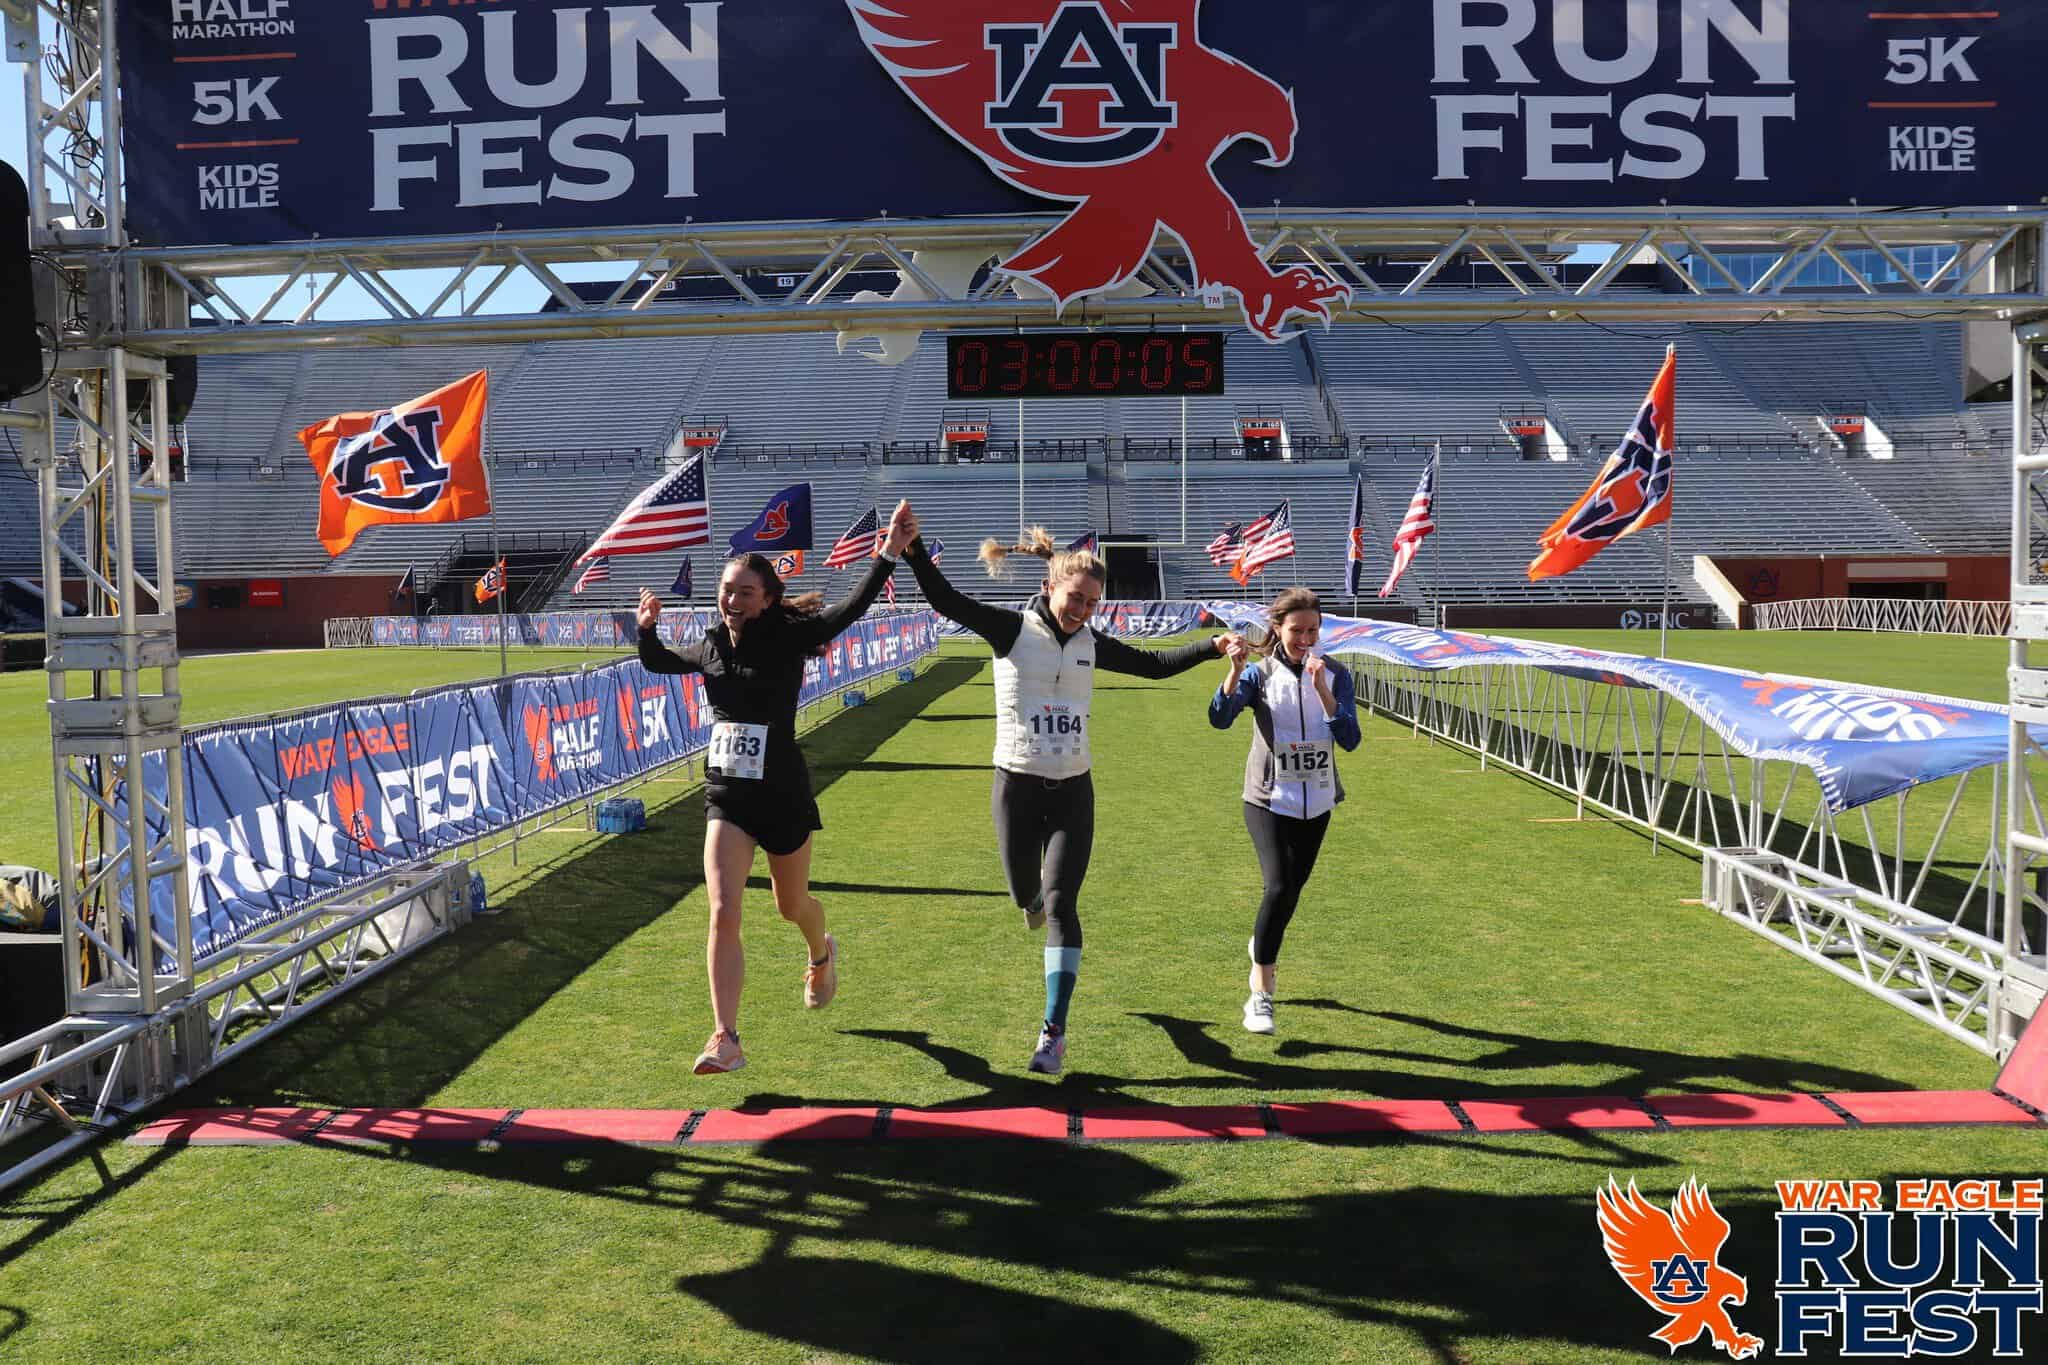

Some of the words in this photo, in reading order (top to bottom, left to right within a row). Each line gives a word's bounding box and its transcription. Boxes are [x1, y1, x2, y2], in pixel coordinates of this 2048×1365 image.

[172, 0, 290, 22] HALF
[172, 20, 296, 39] MARATHON
[365, 2, 725, 117] RUN
[1431, 0, 1796, 84] RUN
[1884, 36, 1981, 83] 5K
[192, 77, 282, 125] 5K
[1430, 92, 1796, 182] FEST
[1888, 126, 1976, 150] KIDS
[198, 163, 280, 189] KIDS
[368, 108, 726, 212] FEST
[1889, 149, 1976, 172] MILE
[199, 184, 280, 210] MILE
[1208, 296, 1221, 304] TM
[957, 339, 1212, 391] 03:00:05
[1645, 612, 1689, 630] PNC
[552, 715, 600, 753] HALF
[642, 696, 671, 748] 5K
[1030, 714, 1082, 734] 1164
[279, 737, 337, 780] WAR
[714, 735, 761, 757] 1163
[1278, 750, 1329, 771] 1152
[377, 744, 499, 848] FEST
[185, 791, 339, 916] RUN
